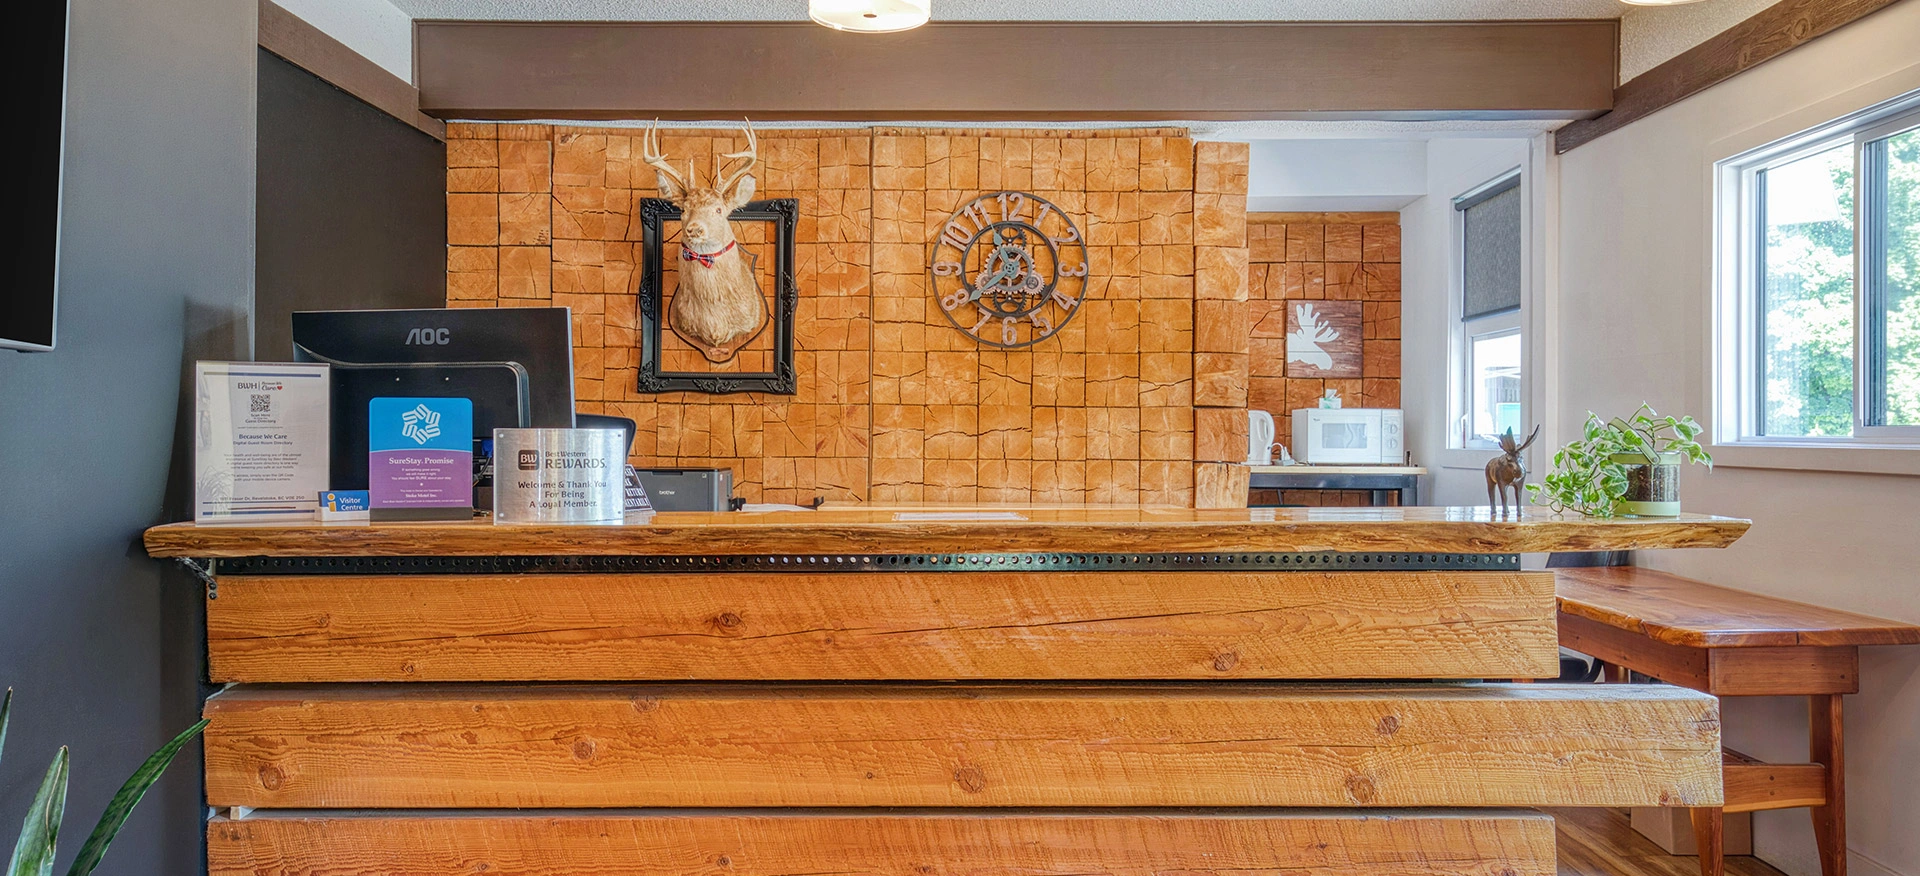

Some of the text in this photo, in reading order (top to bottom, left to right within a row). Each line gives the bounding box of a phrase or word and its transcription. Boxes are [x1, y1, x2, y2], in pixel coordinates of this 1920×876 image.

[964, 199, 993, 231] 11
[997, 192, 1025, 222] 12
[1033, 202, 1052, 229] 1
[940, 220, 974, 252] 10
[1049, 227, 1079, 251] 2
[932, 261, 963, 277] 9
[1058, 262, 1088, 277] 3
[941, 288, 970, 312] 8
[1051, 289, 1079, 311] 4
[969, 307, 992, 335] 7
[1002, 316, 1017, 346] 6
[1029, 307, 1053, 337] 5
[405, 327, 450, 345] AOC
[237, 382, 258, 390] BWH
[520, 454, 537, 463] BW
[518, 480, 607, 489] Welcome & Thank You
[561, 491, 585, 499] Being
[339, 496, 361, 504] Visitor
